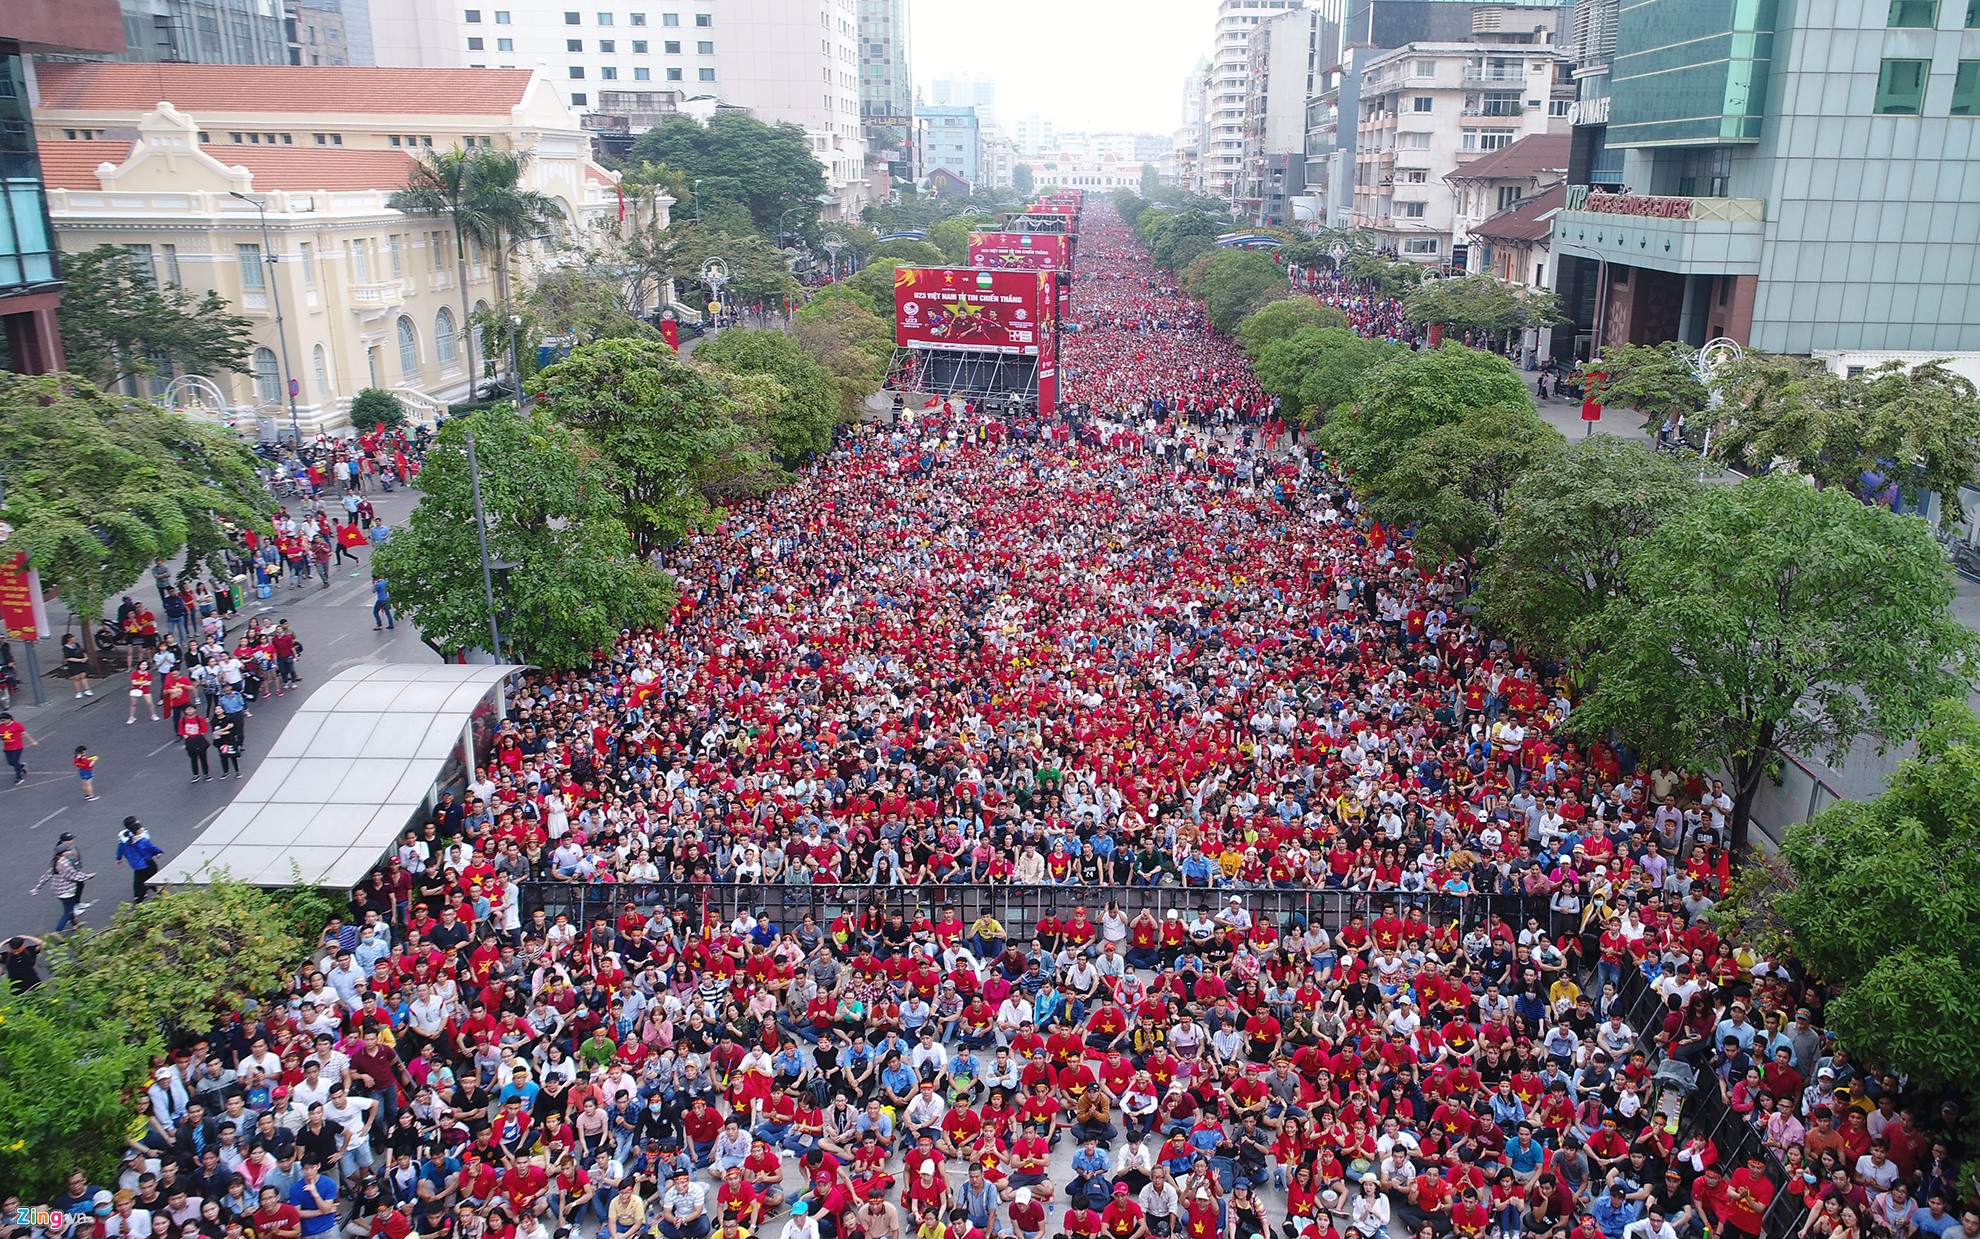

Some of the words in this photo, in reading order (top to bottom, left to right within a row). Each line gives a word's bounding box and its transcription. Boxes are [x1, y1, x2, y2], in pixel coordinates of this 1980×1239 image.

[1567, 185, 1588, 210] VTP
[1586, 195, 1612, 213] OFFICE
[1612, 196, 1649, 215] SERVICE
[1649, 198, 1691, 219] CENTER
[927, 292, 941, 301] VIỆT
